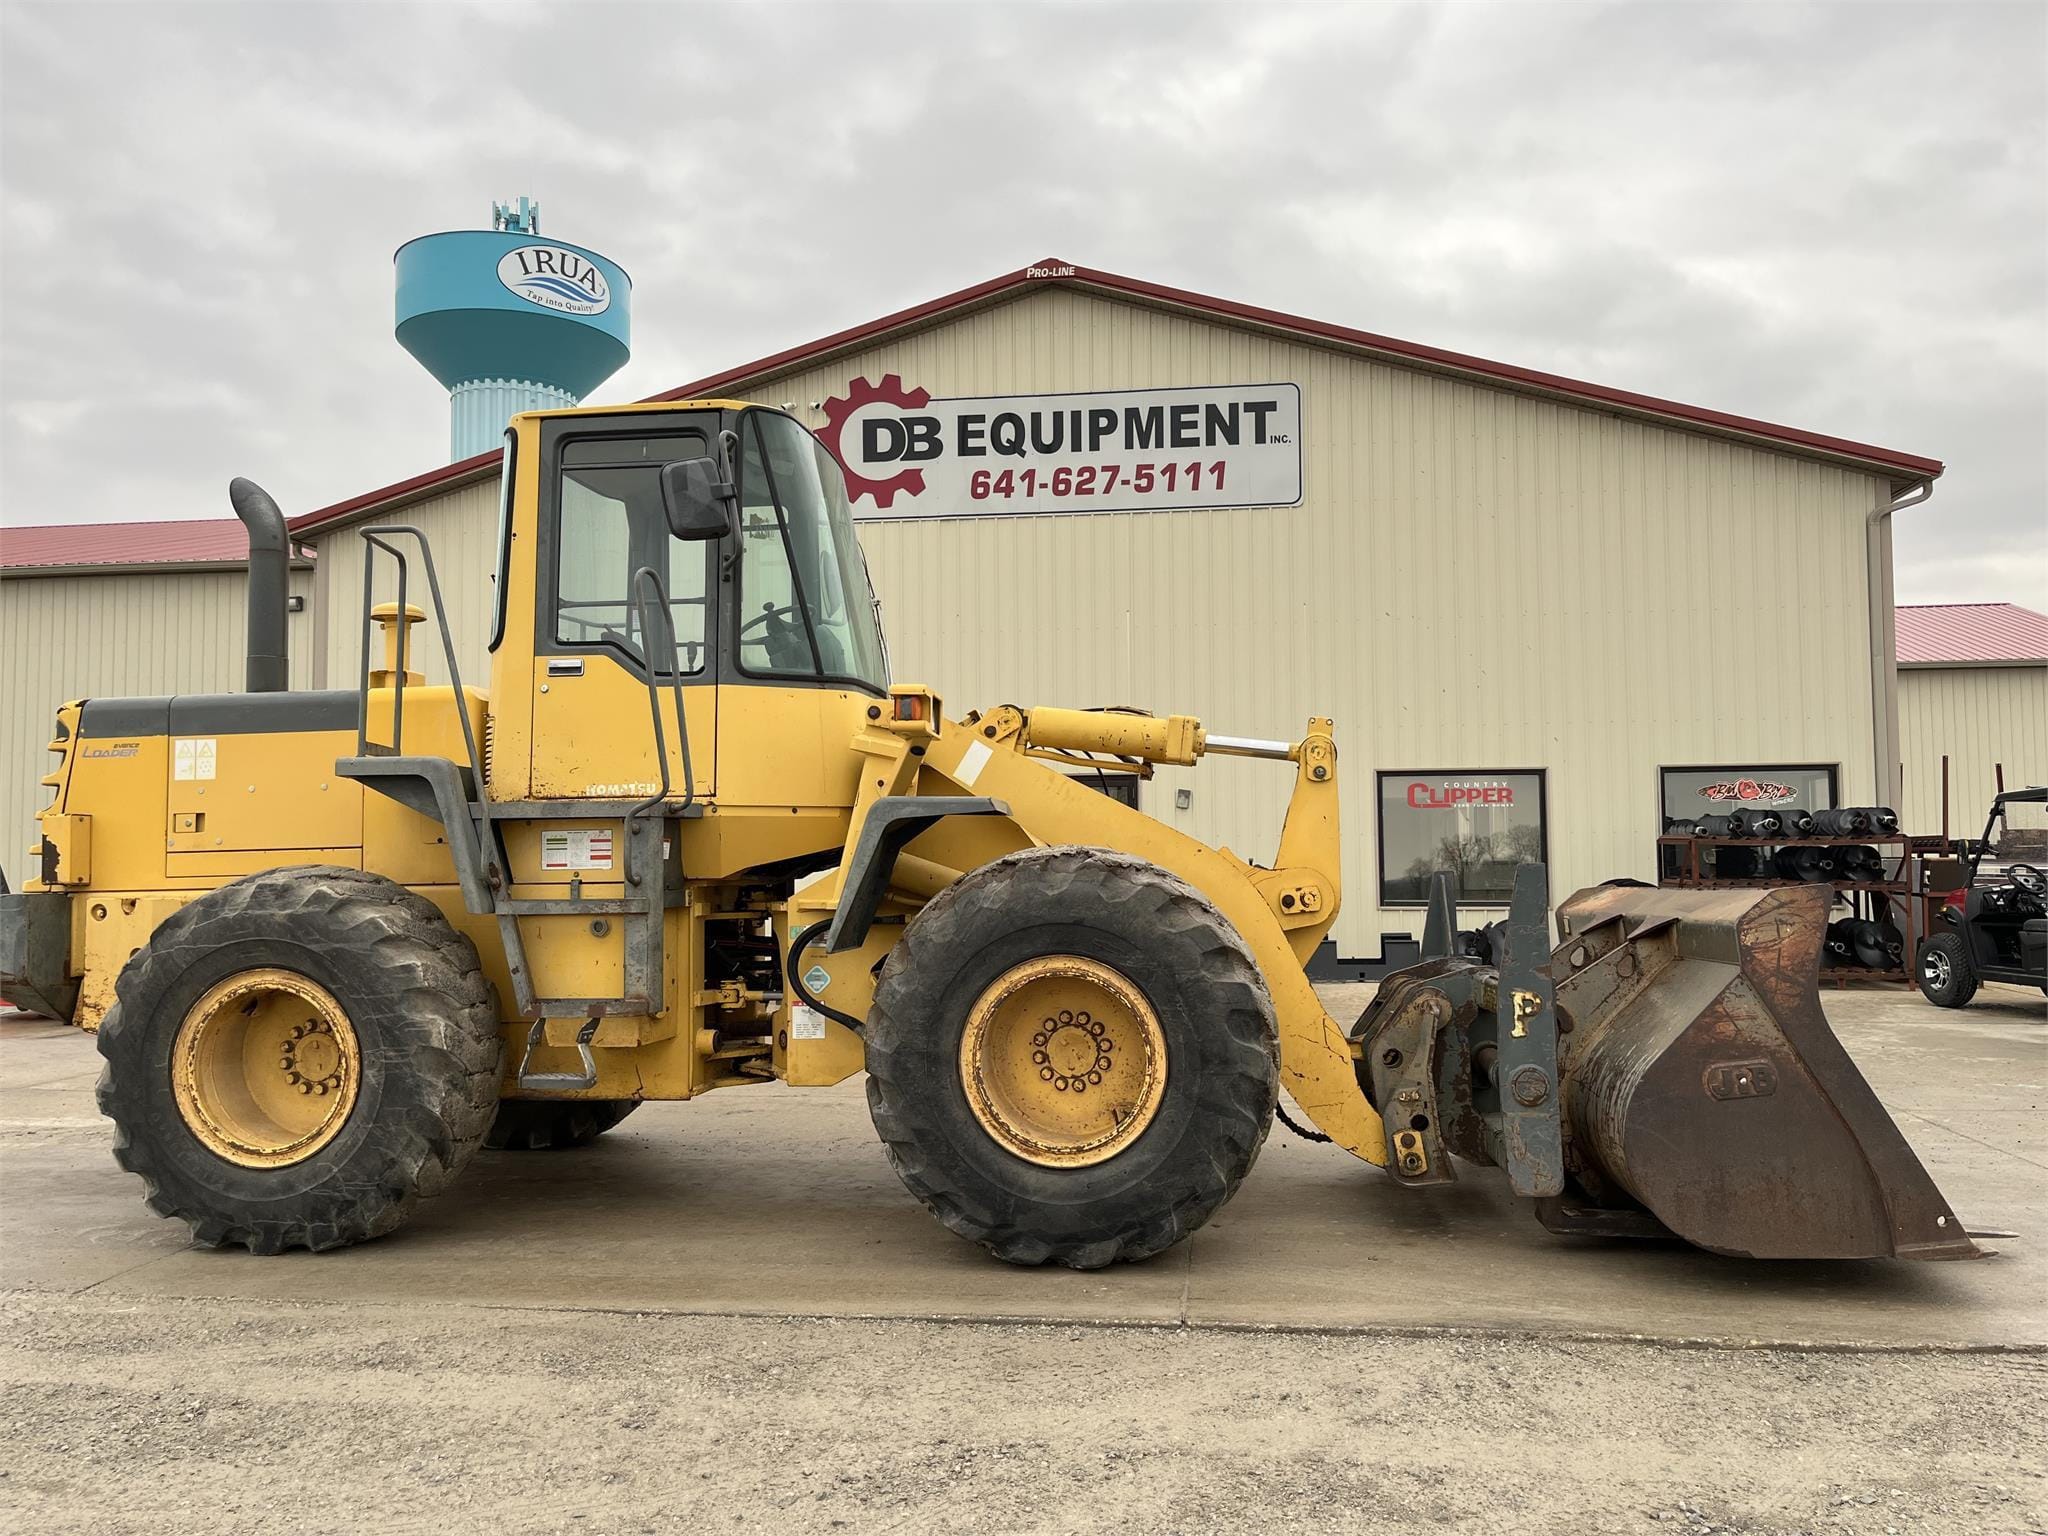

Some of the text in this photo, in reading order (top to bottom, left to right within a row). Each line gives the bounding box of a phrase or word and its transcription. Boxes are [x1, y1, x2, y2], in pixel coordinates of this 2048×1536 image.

[514, 249, 597, 295] IRUA
[1026, 266, 1076, 279] PRO-LINE
[527, 290, 543, 303] Tap
[545, 296, 563, 308] into
[862, 401, 1292, 463] DB EQUIPMENT INC.
[970, 460, 1227, 500] 641-627-5111
[586, 783, 657, 796] KOMATSU
[1407, 782, 1514, 809] CLIPPER
